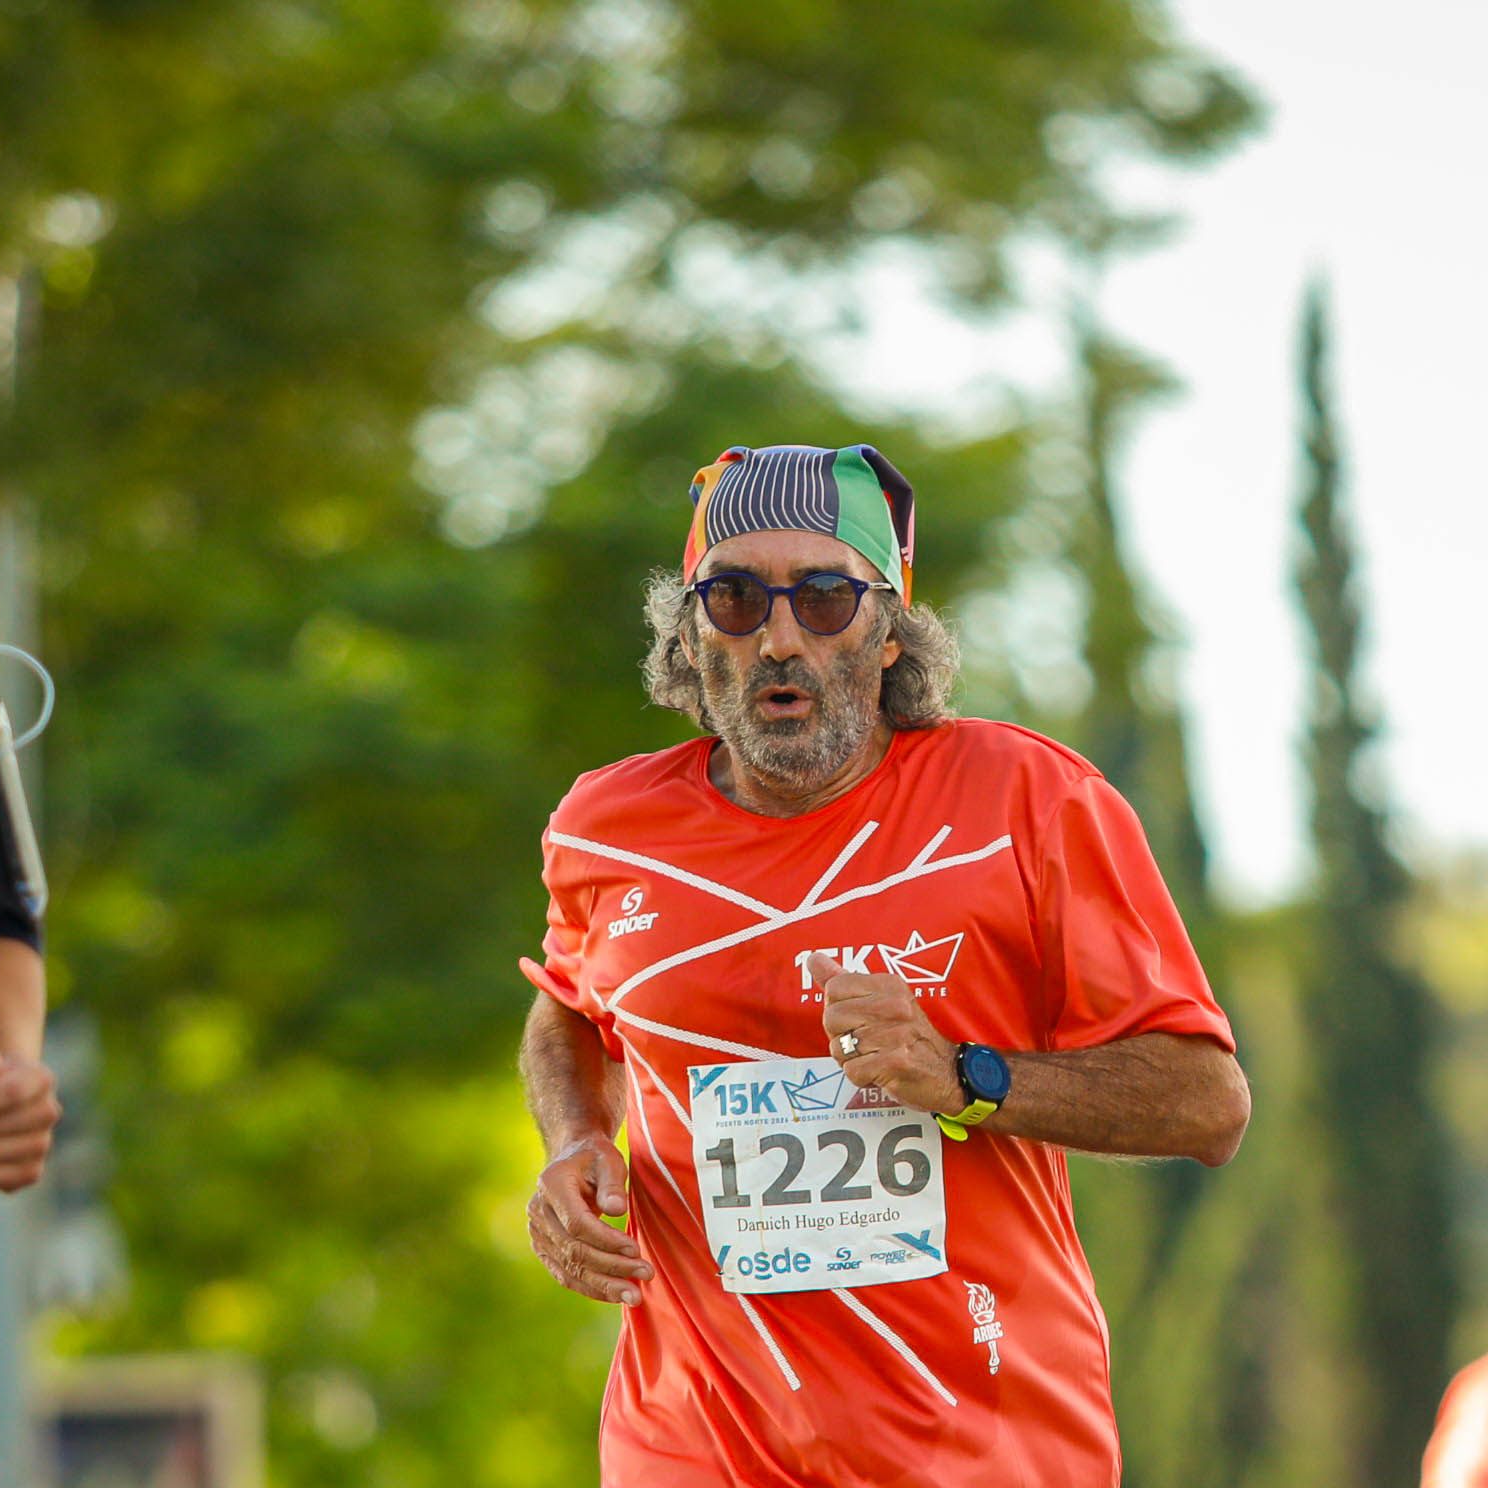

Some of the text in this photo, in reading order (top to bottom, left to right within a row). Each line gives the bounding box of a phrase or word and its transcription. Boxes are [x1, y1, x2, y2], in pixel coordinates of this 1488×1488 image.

[914, 986, 948, 998] RTE
[714, 1081, 778, 1116] 15K
[744, 1118, 769, 1126] NORTE
[849, 1111, 859, 1119] DE
[862, 1110, 884, 1118] ABRIL
[705, 1124, 932, 1209] 1226
[737, 1207, 901, 1232] Daruich Hugo Edgardo
[736, 1246, 812, 1279] osde
[973, 1321, 1004, 1344] ARDEC
